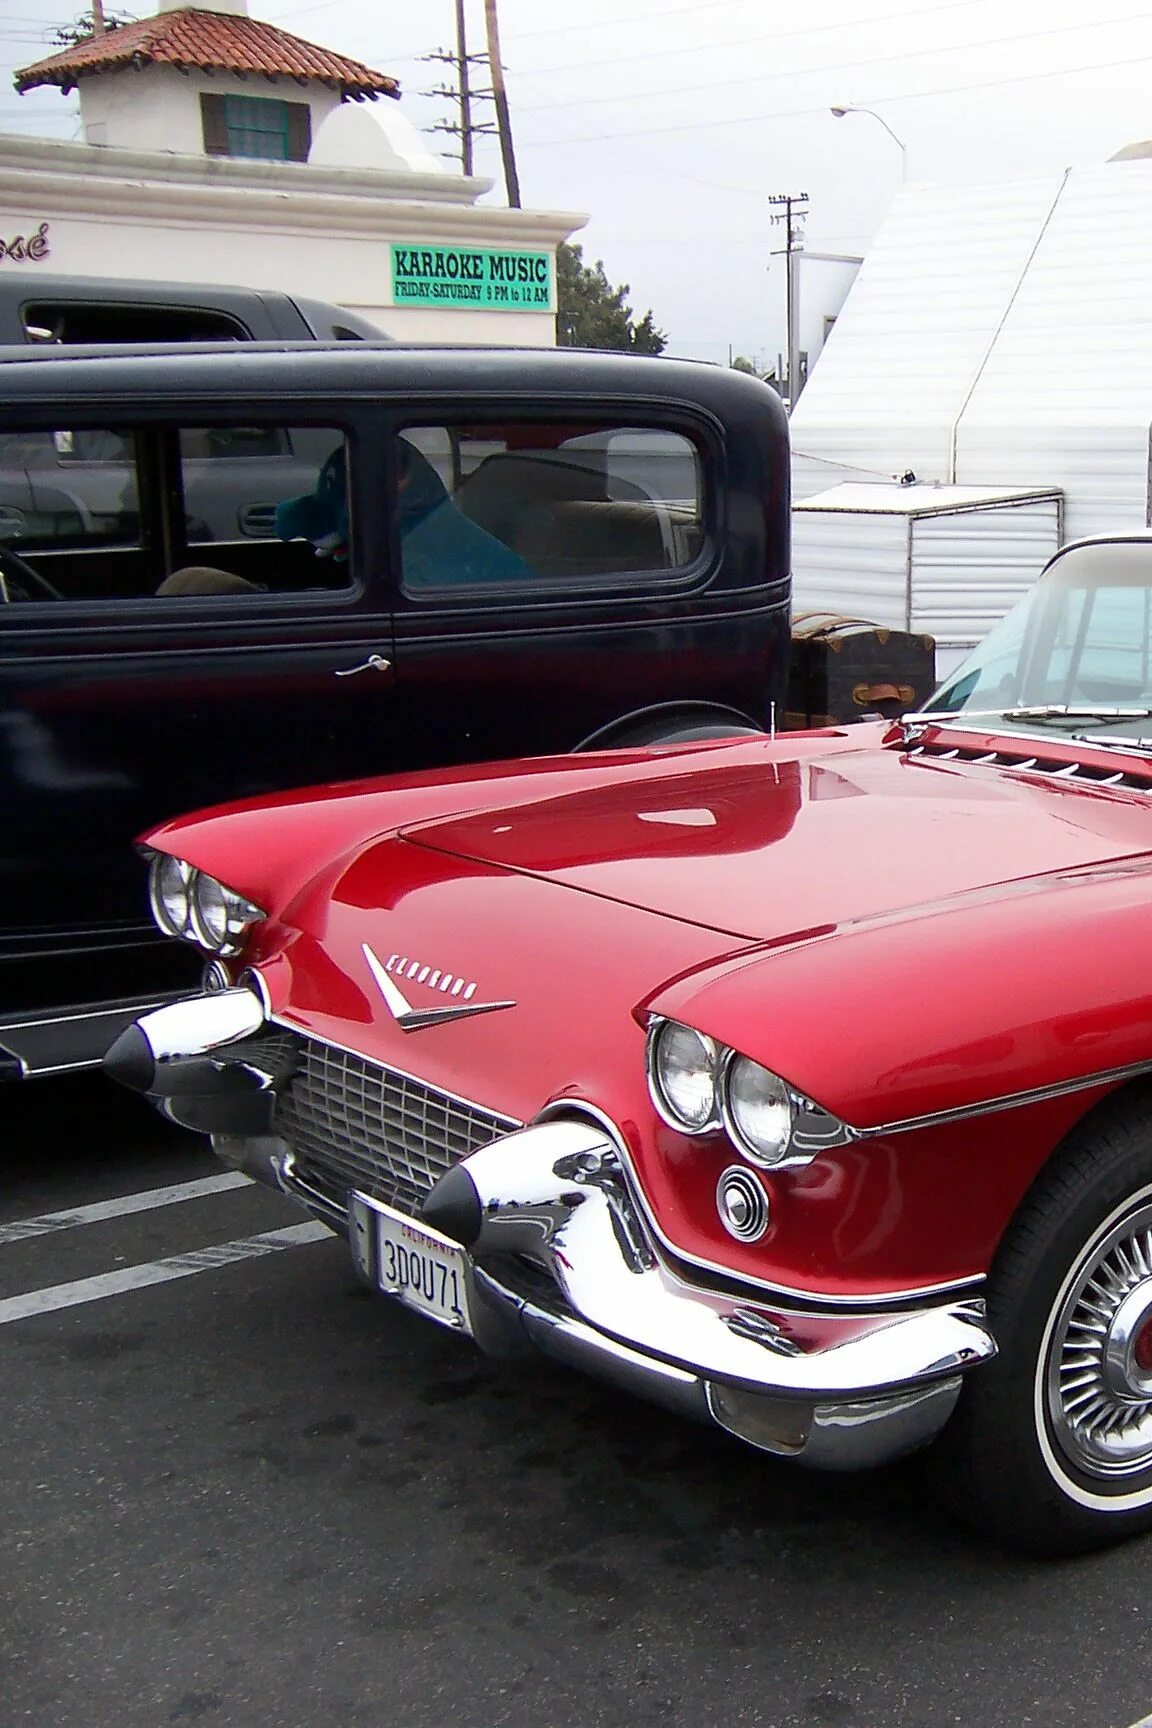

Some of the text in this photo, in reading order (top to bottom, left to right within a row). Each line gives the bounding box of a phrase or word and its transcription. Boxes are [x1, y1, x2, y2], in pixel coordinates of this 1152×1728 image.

[395, 250, 547, 283] KARAOKE MUSIC
[395, 281, 482, 300] FRIDAY-SATURDAY
[494, 286, 508, 301] PM
[511, 287, 519, 301] to
[522, 287, 531, 302] 12
[534, 287, 548, 302] AM
